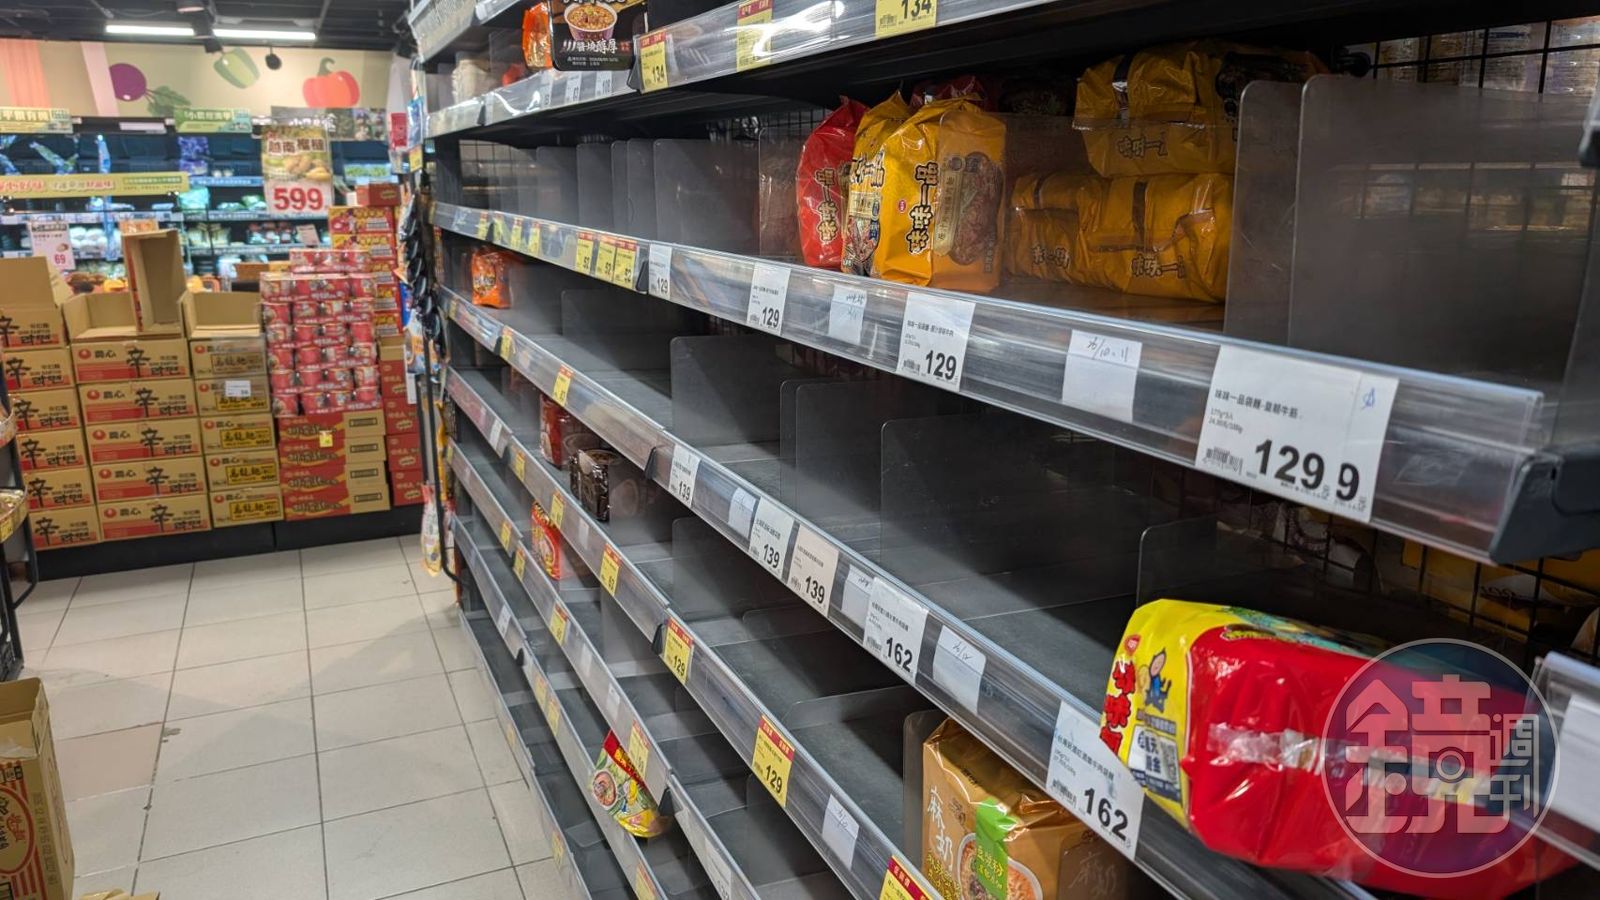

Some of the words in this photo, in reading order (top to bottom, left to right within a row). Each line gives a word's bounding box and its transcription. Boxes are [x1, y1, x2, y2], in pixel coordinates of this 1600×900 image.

[902, 0, 931, 19] 134
[652, 65, 664, 82] 134
[273, 187, 323, 211] 599
[906, 161, 939, 255] 味味一品
[54, 254, 66, 264] 69
[656, 277, 669, 294] 129
[762, 306, 780, 329] 129
[925, 349, 957, 380] 129
[1254, 439, 1325, 490] 129
[678, 481, 690, 500] 139
[1336, 463, 1360, 501] 9
[763, 543, 780, 569] 139
[805, 575, 825, 604] 139
[673, 655, 685, 676] 129
[886, 637, 913, 672] 162
[765, 764, 782, 793] 129
[1084, 787, 1128, 841] 162
